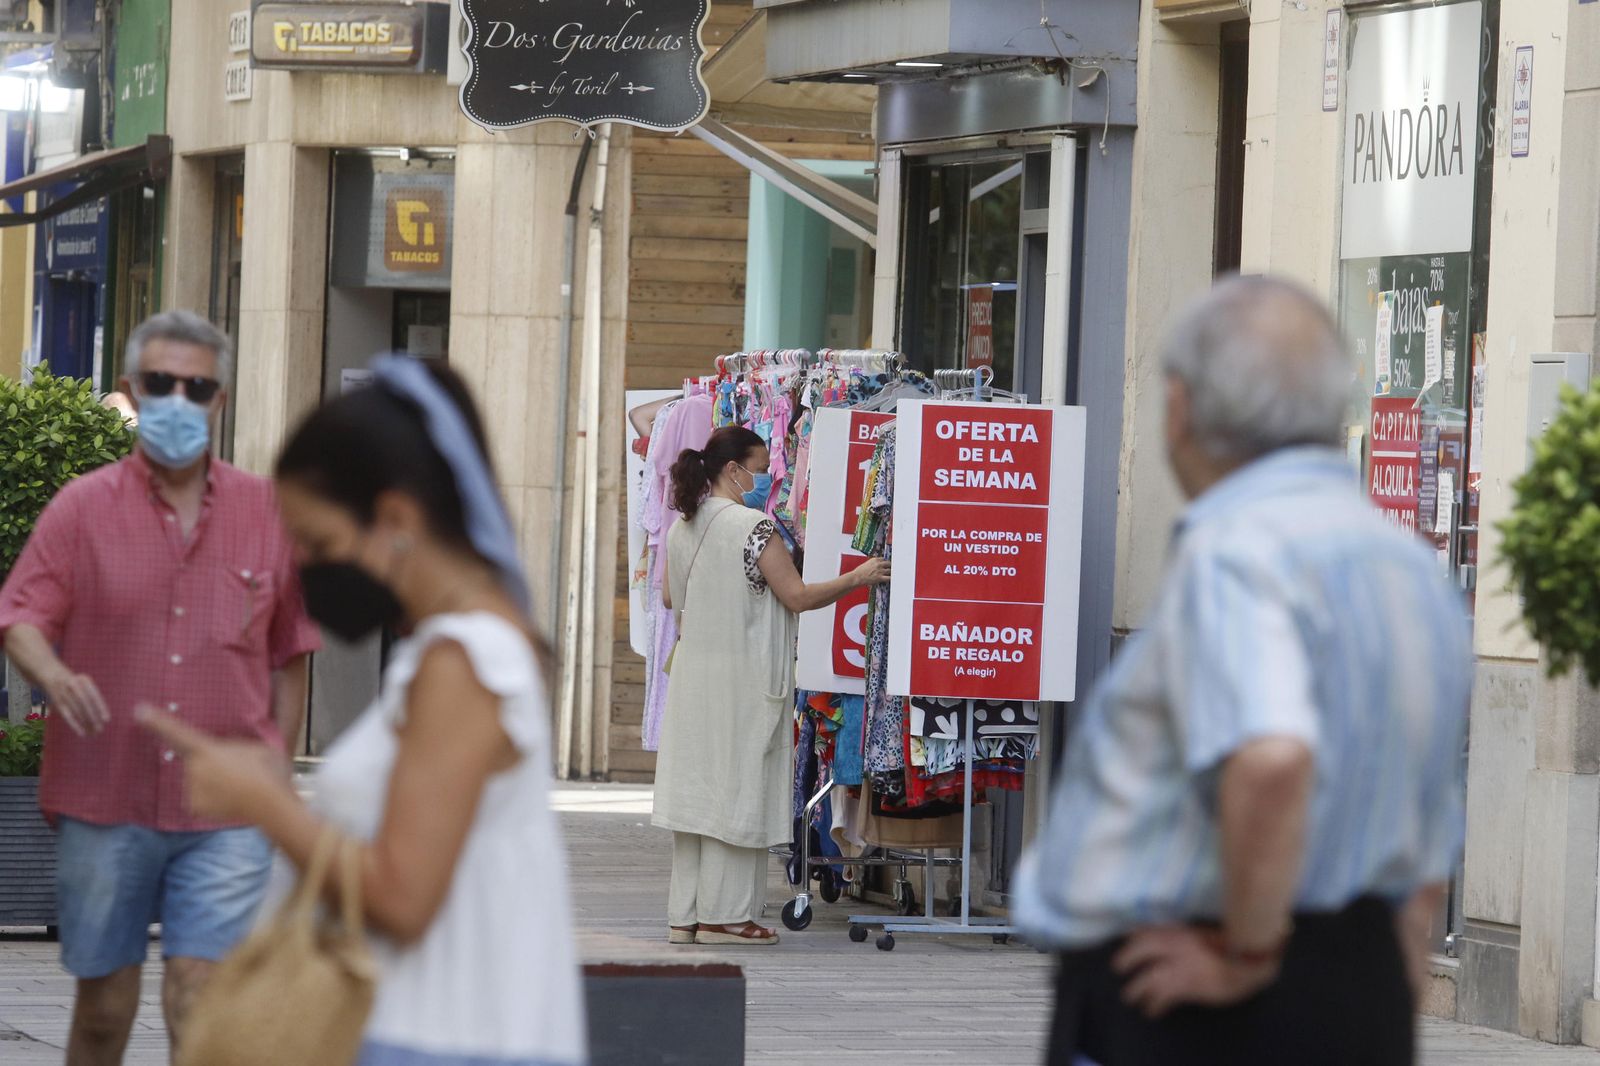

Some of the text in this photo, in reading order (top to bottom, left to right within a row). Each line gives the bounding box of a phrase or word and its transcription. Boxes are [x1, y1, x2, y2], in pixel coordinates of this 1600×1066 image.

[300, 21, 391, 43] TABACOS
[484, 10, 684, 64] Dos Gardenias
[542, 71, 619, 108] by Toril
[1352, 101, 1464, 184] PANDORA
[391, 251, 440, 264] TABACOS
[1430, 269, 1444, 291] 70%
[1393, 358, 1411, 387] 50%
[935, 419, 1039, 443] OFERTA
[1372, 411, 1419, 441] CAPITAN
[958, 447, 1014, 463] DE LA
[934, 469, 1037, 490] SEMANA
[1371, 464, 1414, 498] ALQUILA
[922, 528, 1042, 543] POR LA COMPRA DE
[944, 542, 1019, 555] UN VESTIDO
[944, 564, 1017, 577] AL 20% DTO
[919, 621, 1033, 645] BAÑADOR
[927, 646, 1024, 663] DE REGALO
[954, 665, 997, 678] (A elegir)
